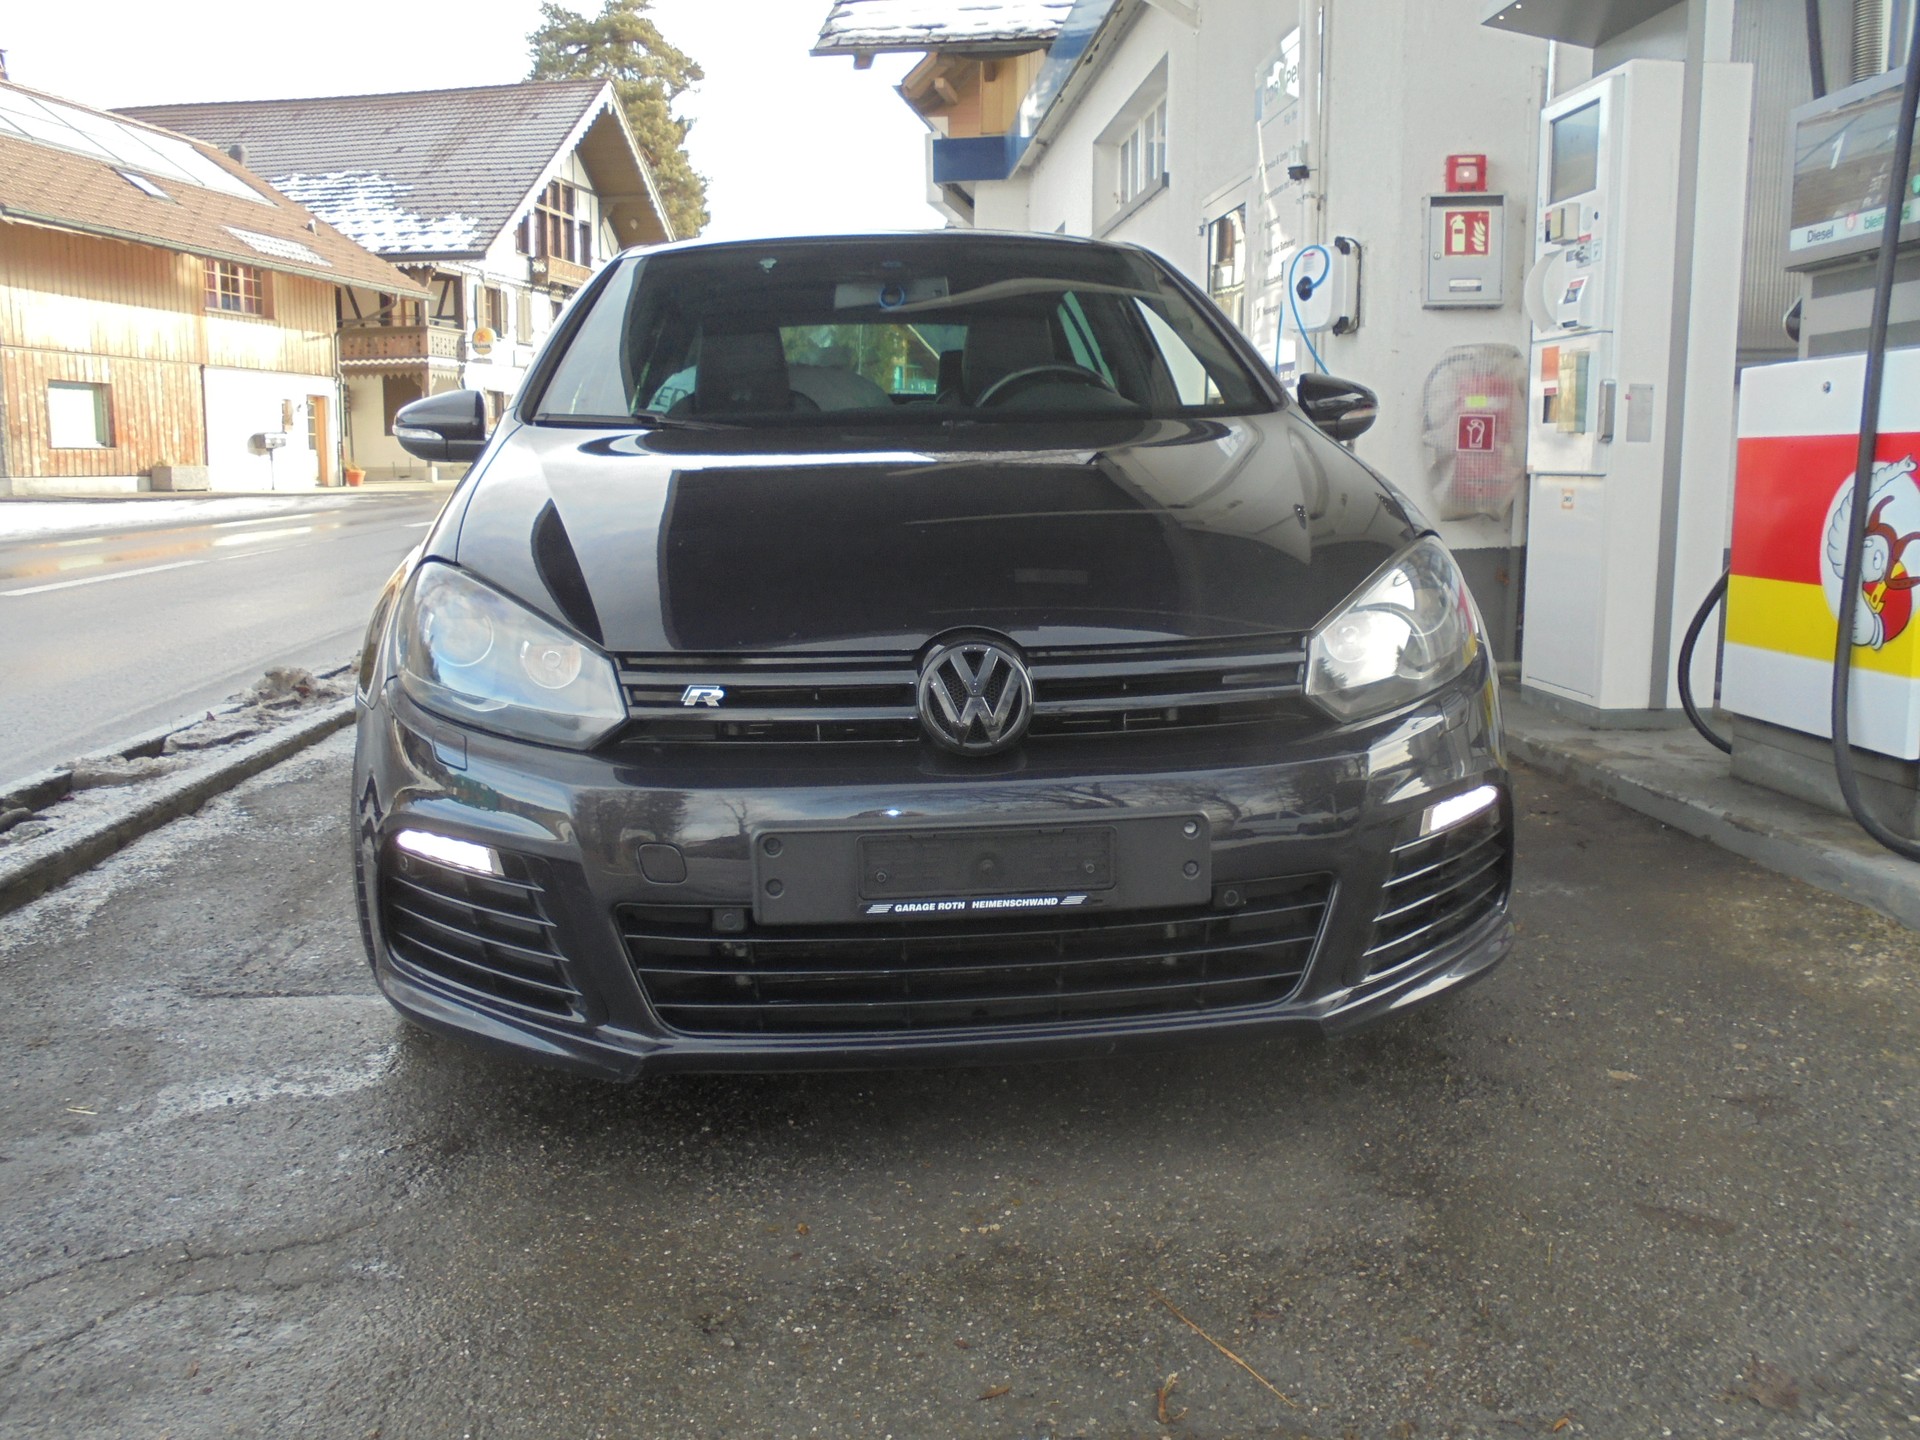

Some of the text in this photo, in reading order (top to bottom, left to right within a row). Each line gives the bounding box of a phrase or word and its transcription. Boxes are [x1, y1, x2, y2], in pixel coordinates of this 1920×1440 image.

[1807, 225, 1834, 243] Diesel
[681, 685, 725, 707] R
[895, 897, 1059, 913] GARAGE ROTH HEIMENSCHWAND
